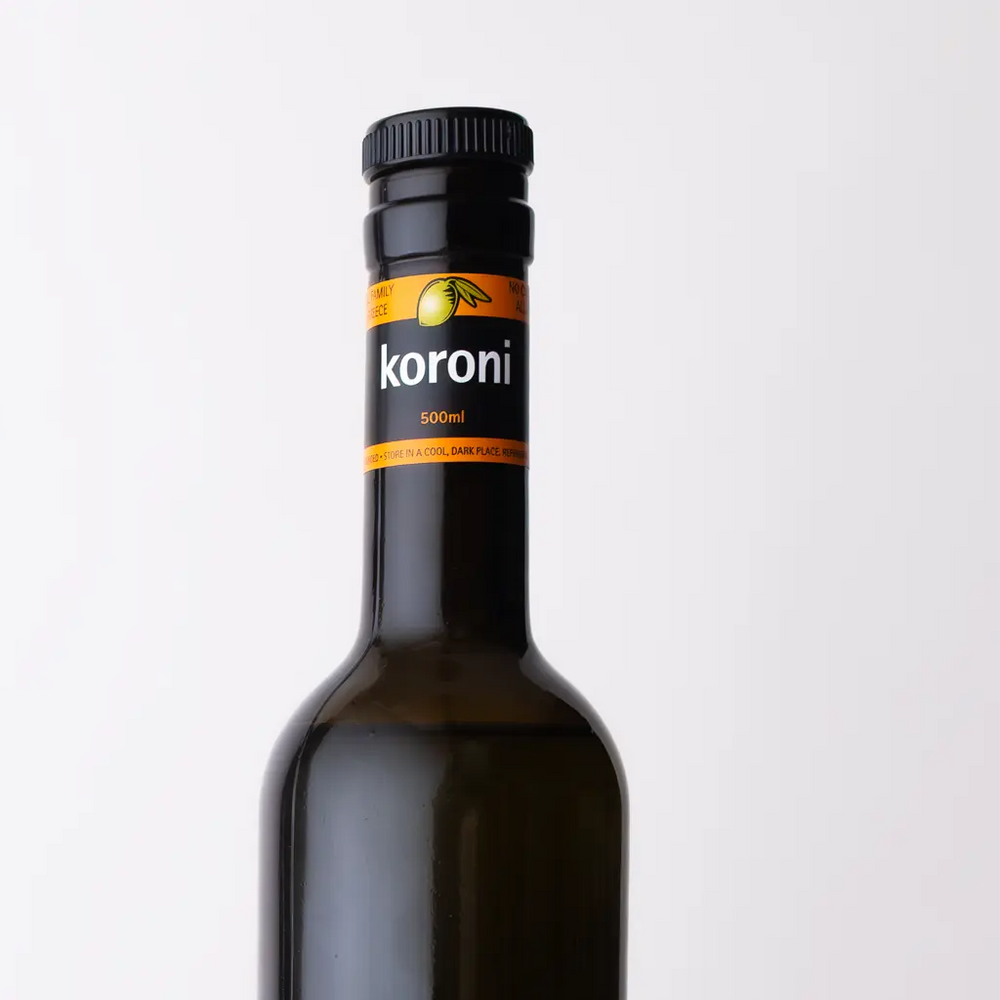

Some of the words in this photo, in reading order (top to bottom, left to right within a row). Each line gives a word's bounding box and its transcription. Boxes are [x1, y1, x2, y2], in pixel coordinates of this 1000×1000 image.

[381, 339, 511, 390] koroni
[420, 410, 465, 425] 500ml
[416, 448, 422, 457] A
[451, 446, 474, 456] DARK
